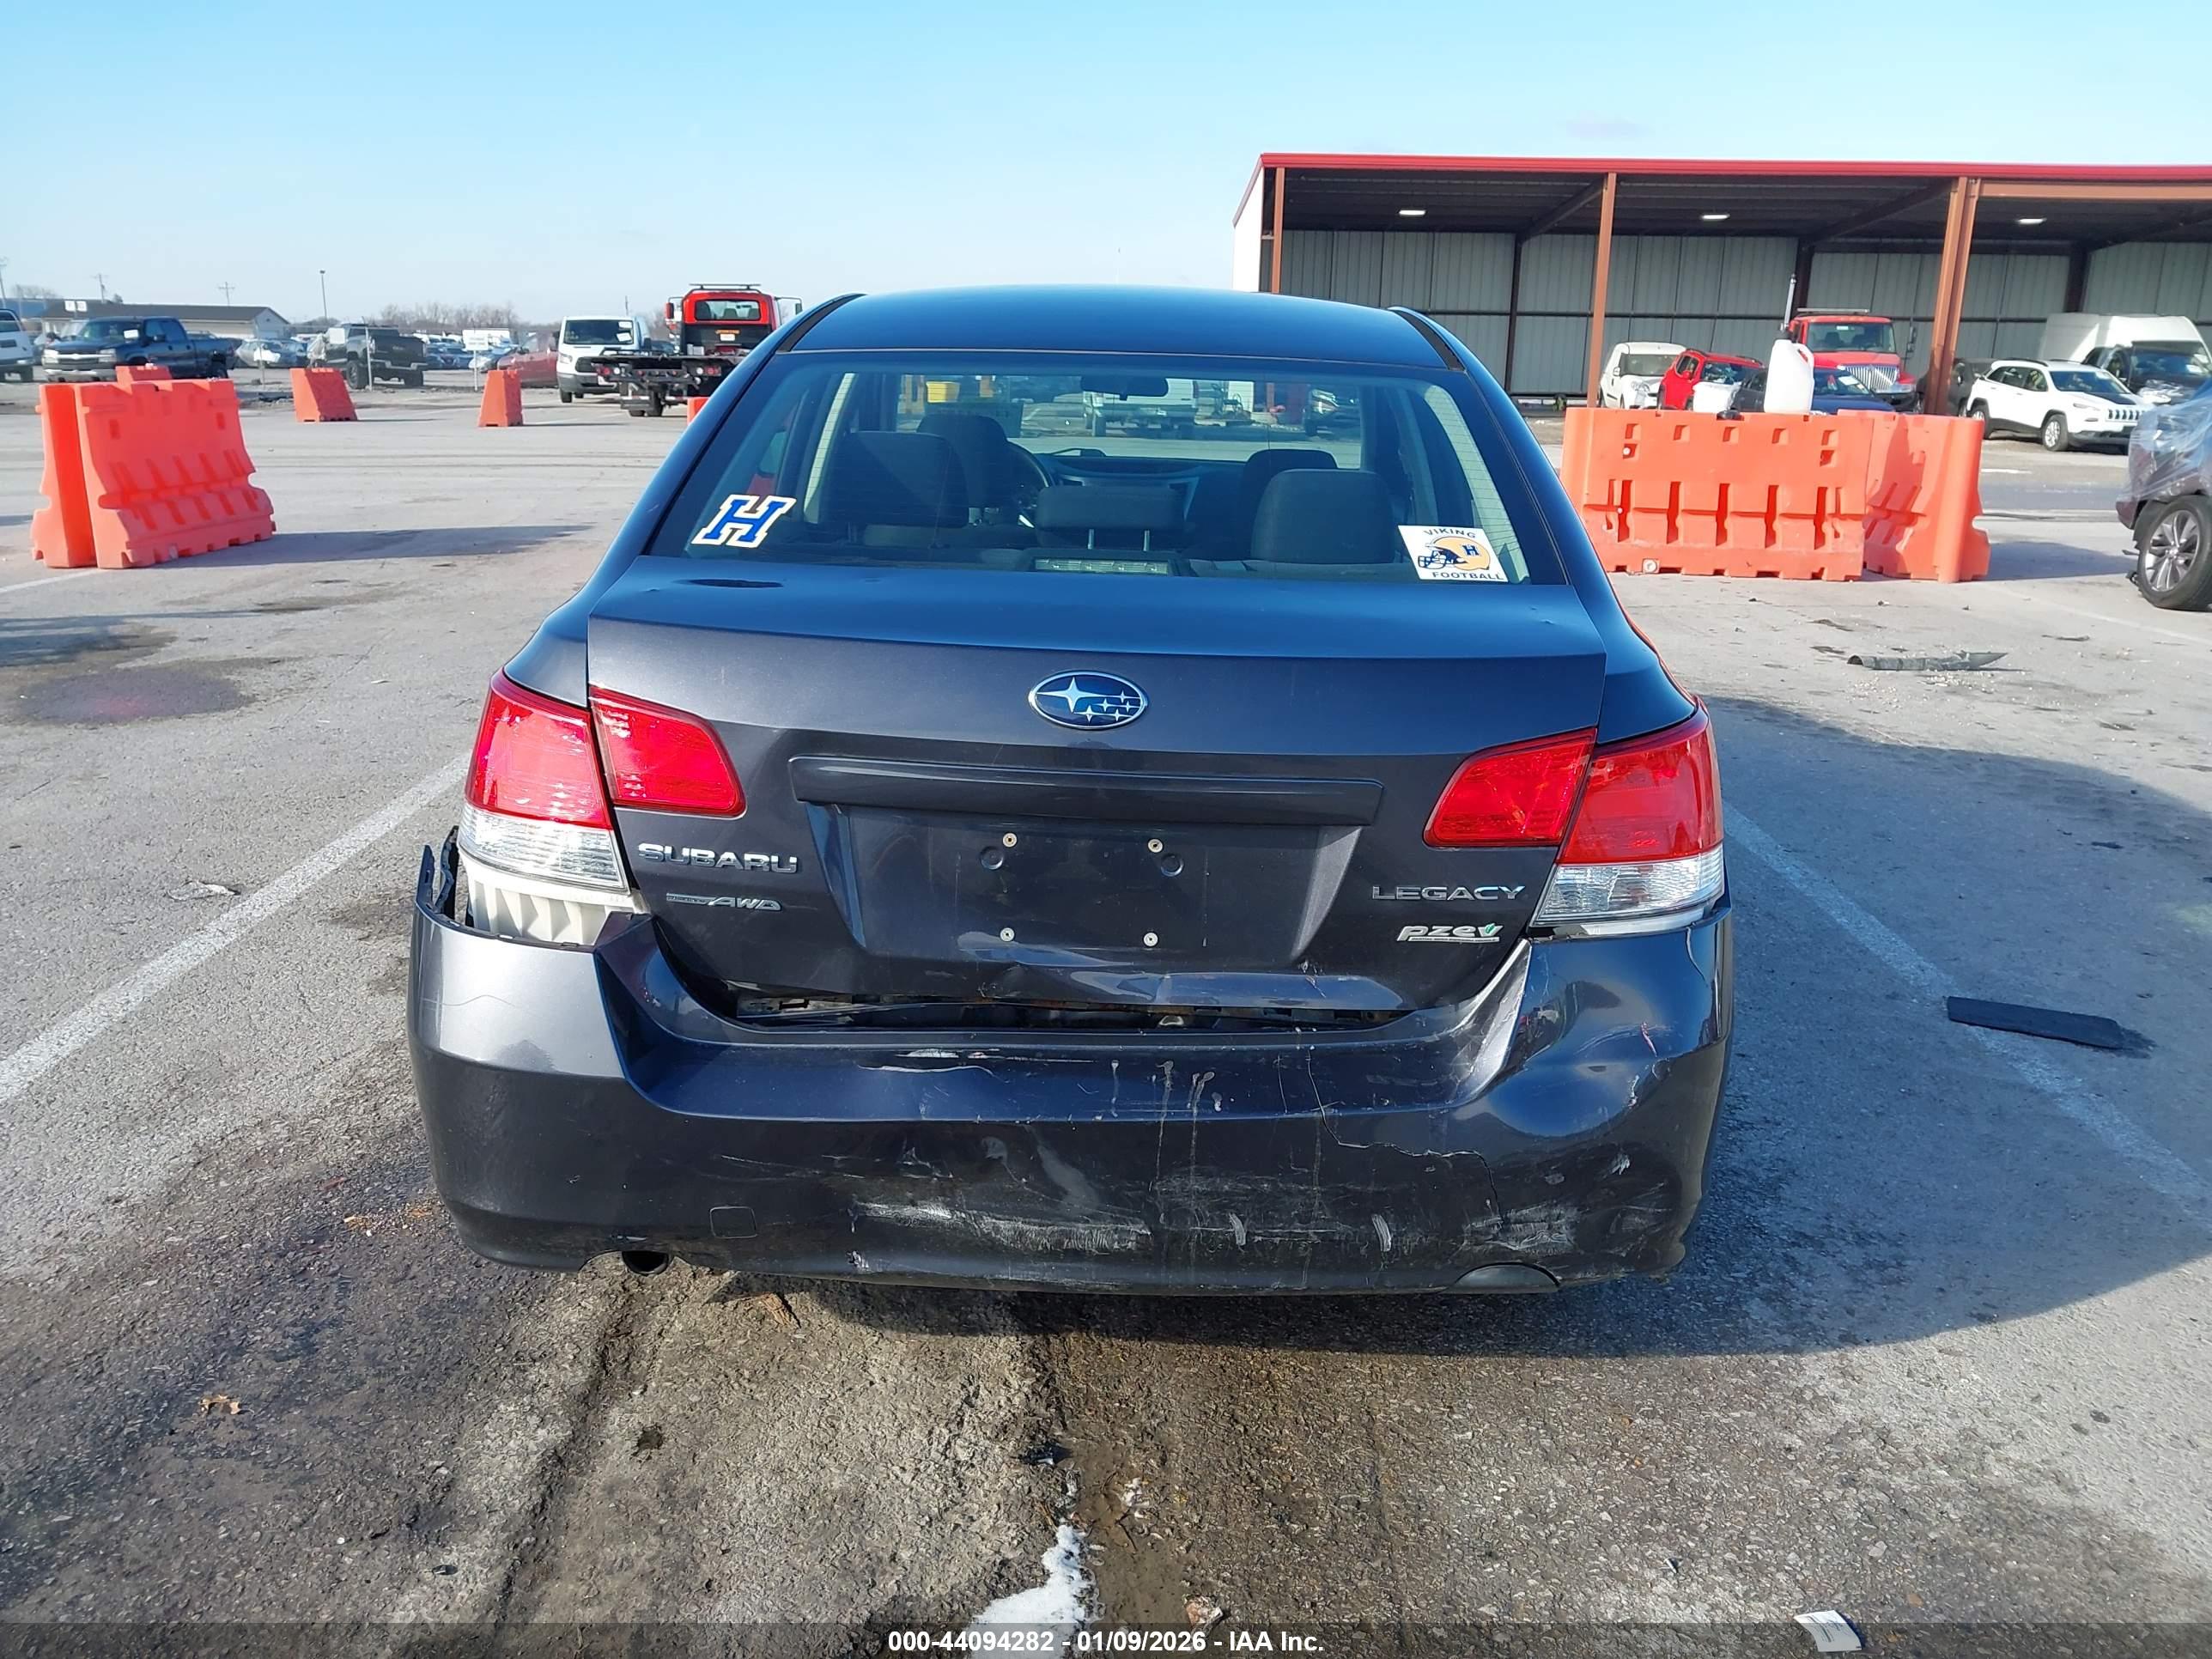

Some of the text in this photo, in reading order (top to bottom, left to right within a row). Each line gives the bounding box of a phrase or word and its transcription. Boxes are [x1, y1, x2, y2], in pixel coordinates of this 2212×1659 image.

[691, 495, 797, 548] H
[1423, 528, 1476, 538] VIKING
[1432, 571, 1504, 580] FOOTBALL
[638, 842, 798, 873] SUBARU
[1372, 885, 1525, 900] LEGACY
[708, 896, 781, 910] AWD
